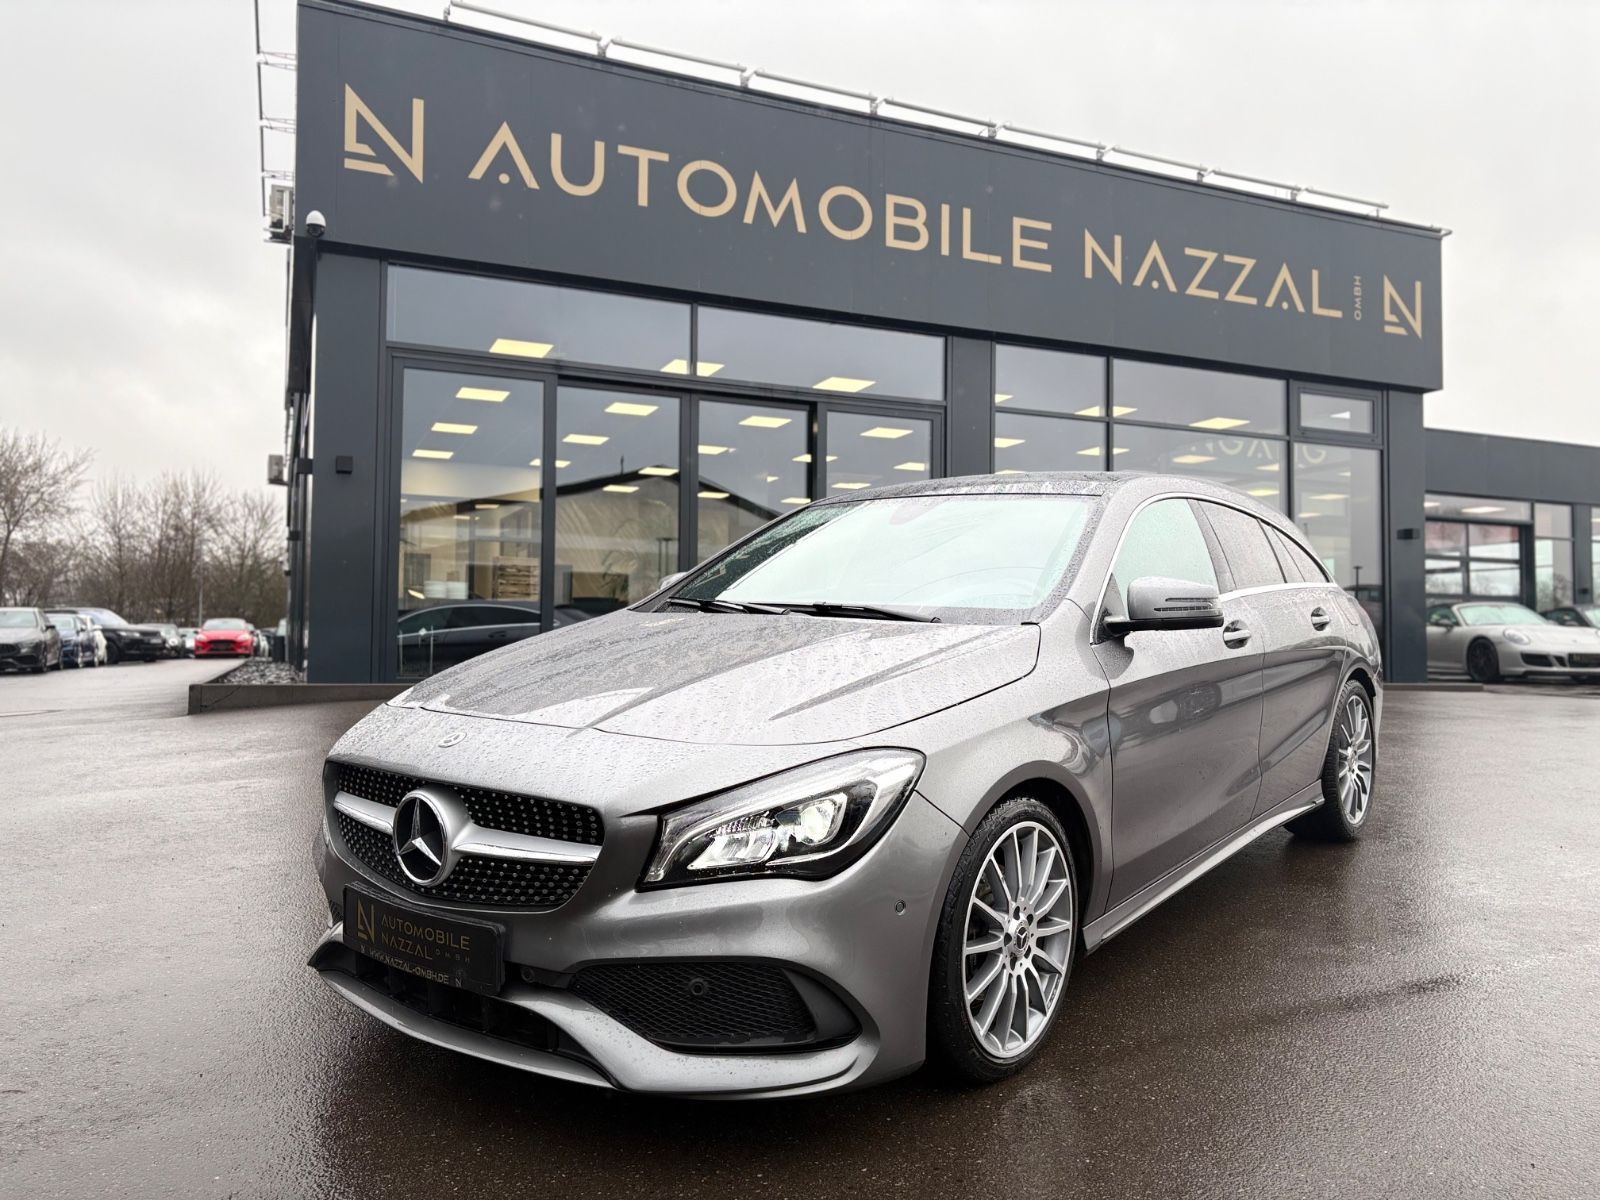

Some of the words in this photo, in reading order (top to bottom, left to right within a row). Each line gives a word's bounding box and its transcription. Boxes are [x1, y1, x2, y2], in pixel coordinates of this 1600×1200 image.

[468, 121, 1053, 274] AUTOMOBILE
[1084, 227, 1343, 320] NAZZAL
[381, 914, 471, 951] AUTOMOBILE
[381, 932, 433, 960] NAZZAL
